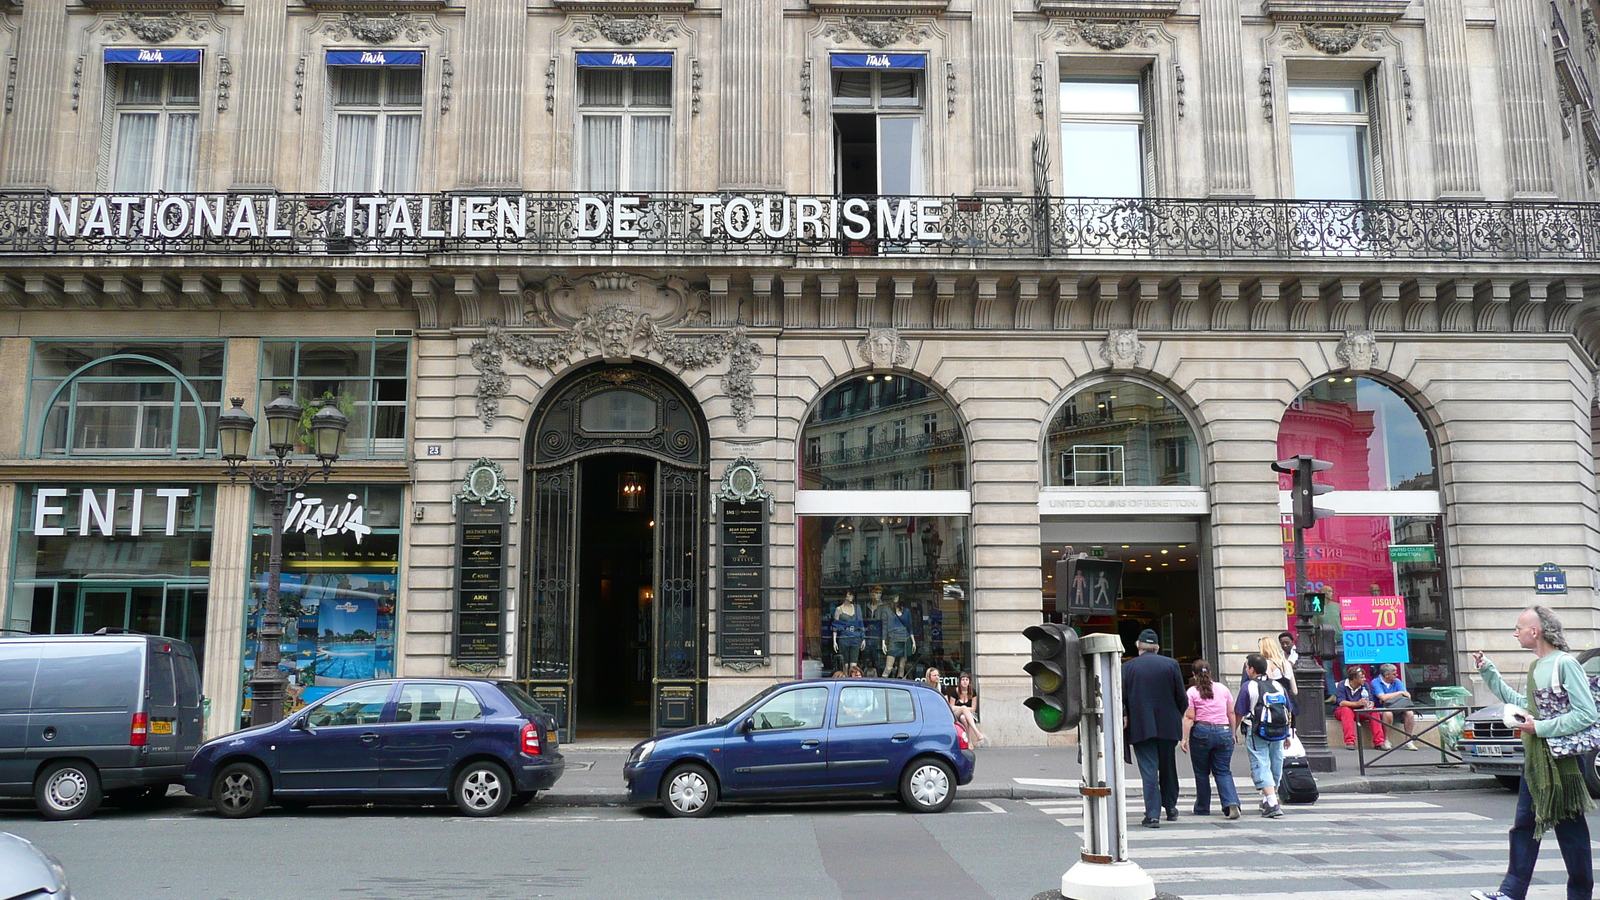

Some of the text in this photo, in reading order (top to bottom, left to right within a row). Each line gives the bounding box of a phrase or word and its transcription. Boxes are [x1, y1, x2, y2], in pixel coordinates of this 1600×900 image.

[47, 196, 944, 241] NATIONAL ITALIEN DE TOURISME
[430, 446, 439, 455] 23
[1049, 499, 1086, 509] UNITED
[1088, 499, 1126, 509] COLORS
[1128, 499, 1142, 509] OF
[34, 488, 191, 536] ENIT
[1371, 597, 1402, 607] JUSQU'À
[1345, 632, 1405, 648] SOLDES
